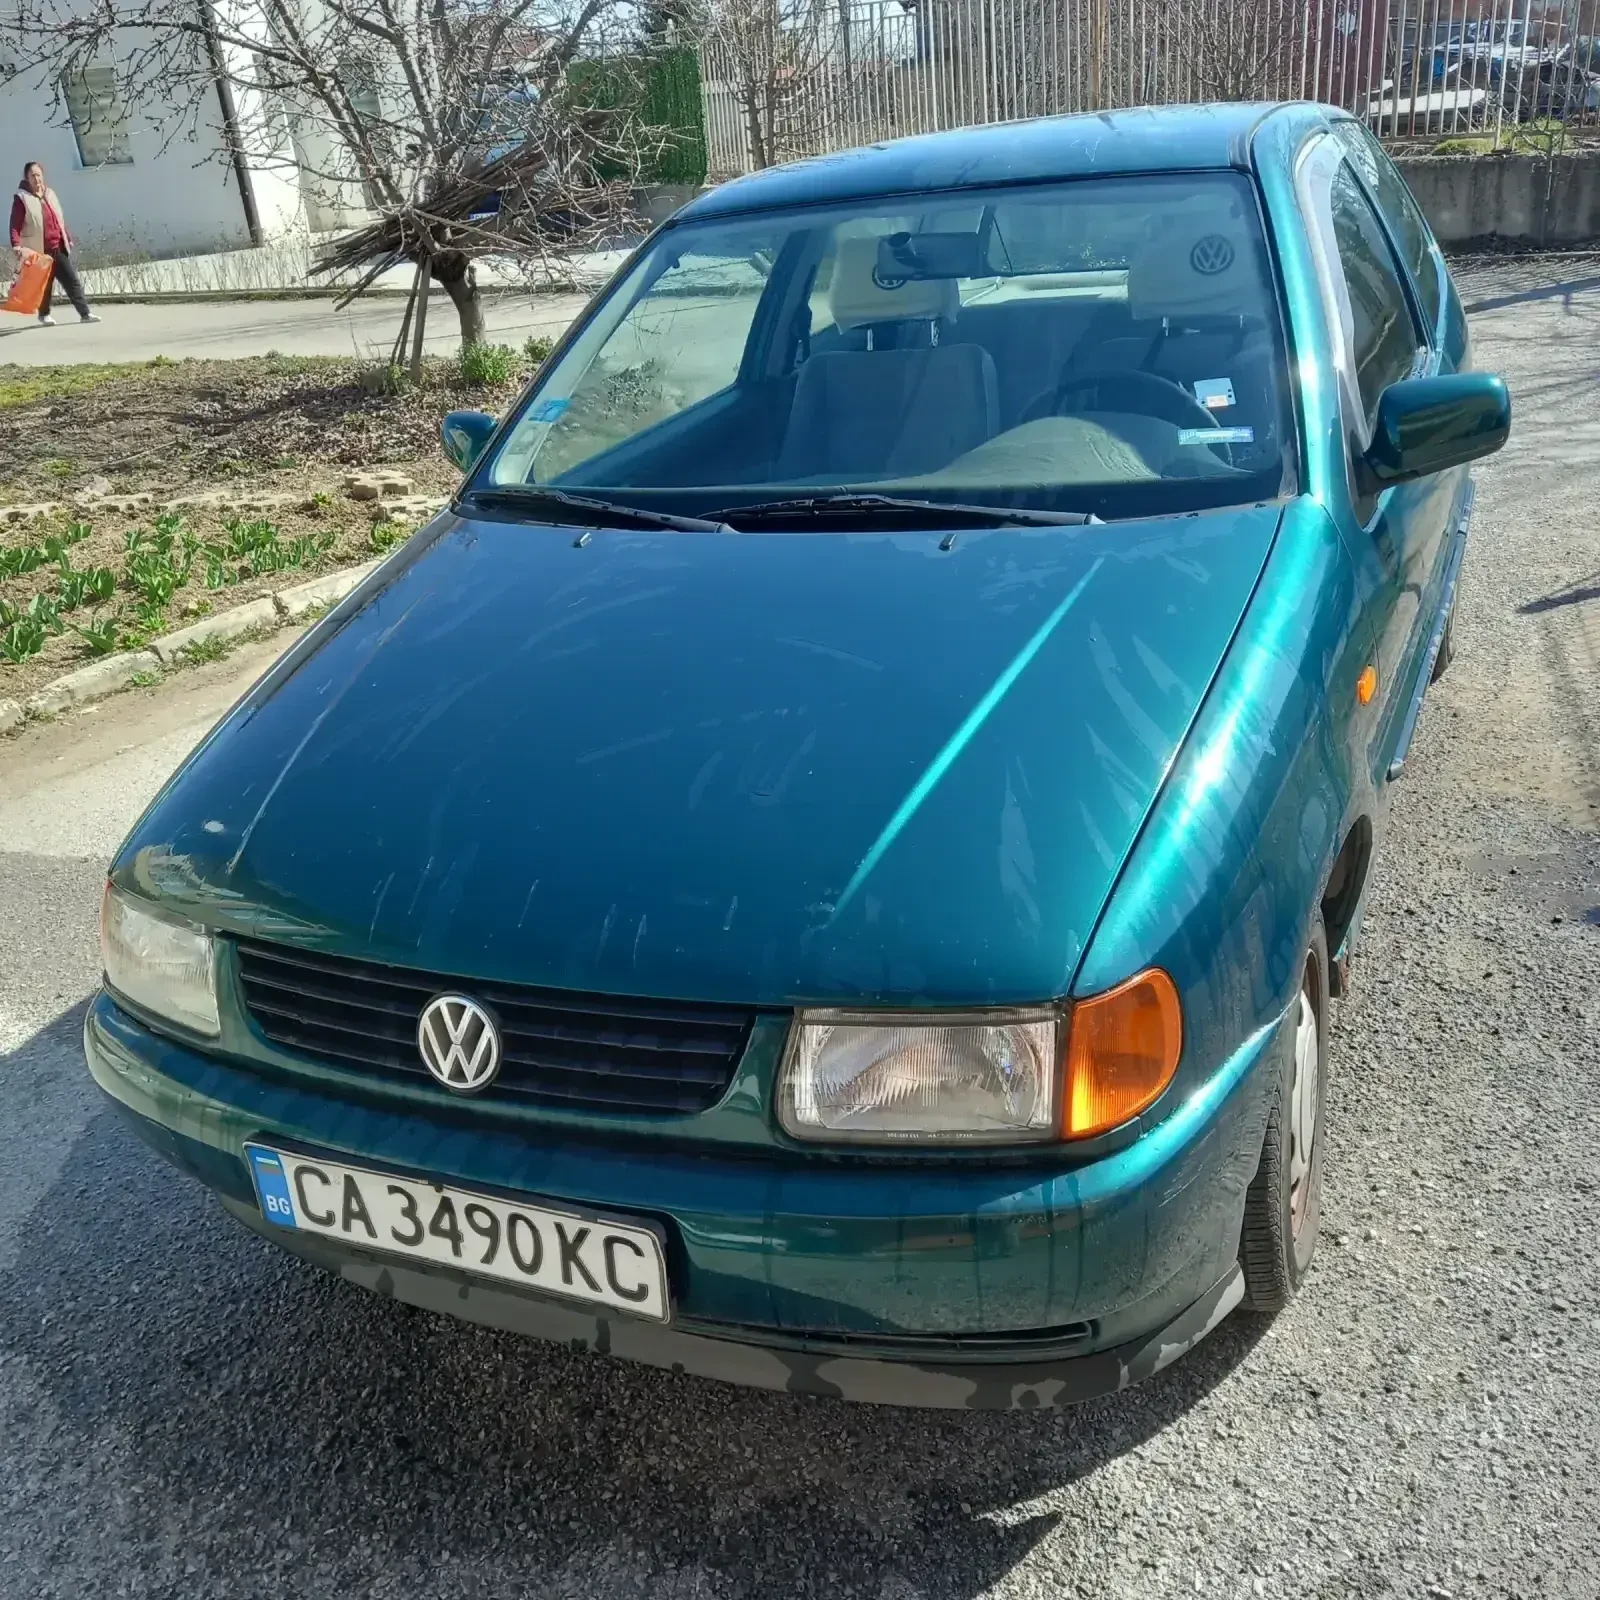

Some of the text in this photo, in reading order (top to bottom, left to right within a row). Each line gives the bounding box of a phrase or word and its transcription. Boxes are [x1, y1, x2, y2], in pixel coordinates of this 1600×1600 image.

[1192, 236, 1233, 274] VW
[419, 996, 498, 1088] VW
[266, 1194, 290, 1215] BG
[294, 1164, 649, 1303] CA 3490 KC
